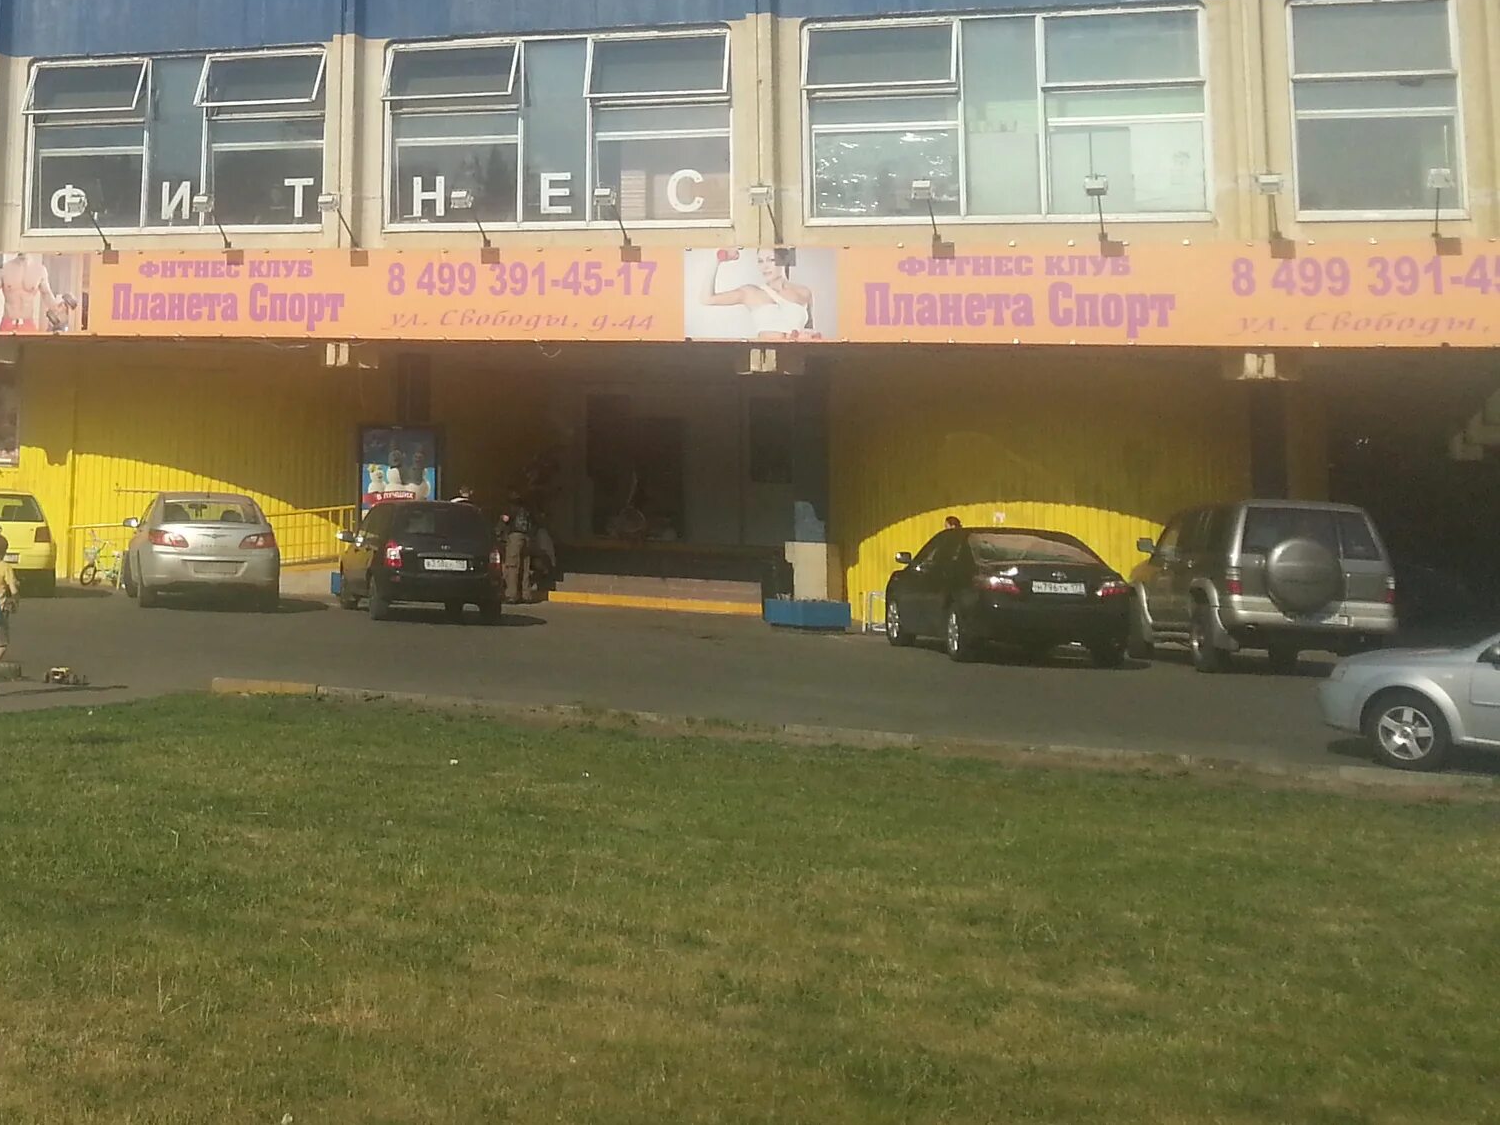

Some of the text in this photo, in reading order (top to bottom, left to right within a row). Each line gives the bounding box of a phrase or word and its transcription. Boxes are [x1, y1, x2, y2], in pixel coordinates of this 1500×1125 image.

[50, 169, 704, 223] ФИТНЕС
[138, 259, 314, 278] ФИТНЕС КЛУБ
[387, 261, 658, 296] 8 499 391-45-17
[897, 254, 1131, 277] ФИТНЕС КЛУБ
[1231, 257, 1256, 297] 8
[1270, 256, 1350, 297] 499
[111, 282, 345, 332] Планета Спорт
[864, 281, 1176, 339] Планета Спорт
